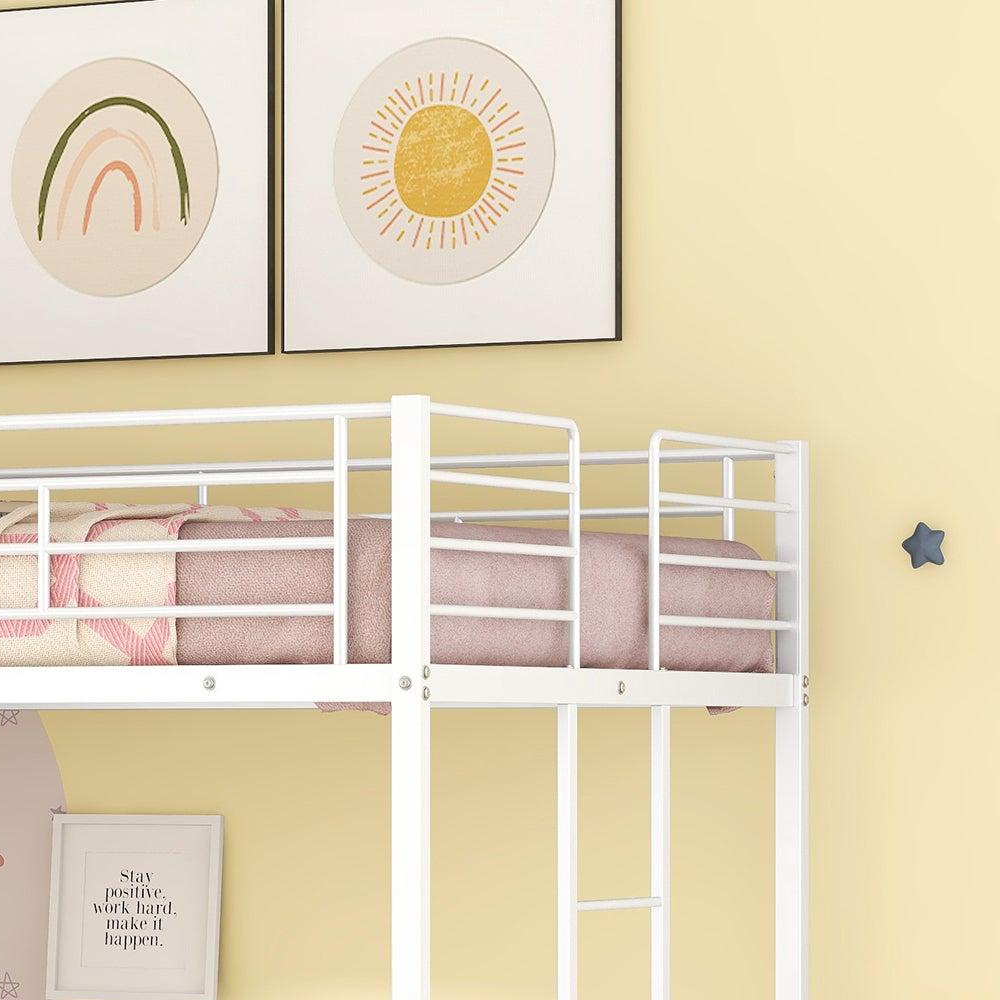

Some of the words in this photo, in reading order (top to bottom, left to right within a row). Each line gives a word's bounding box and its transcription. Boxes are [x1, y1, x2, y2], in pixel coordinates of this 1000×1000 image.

[120, 869, 154, 884] Stay
[93, 900, 130, 914] work
[106, 916, 148, 930] make
[152, 915, 163, 931] it
[104, 932, 163, 950] happen.
